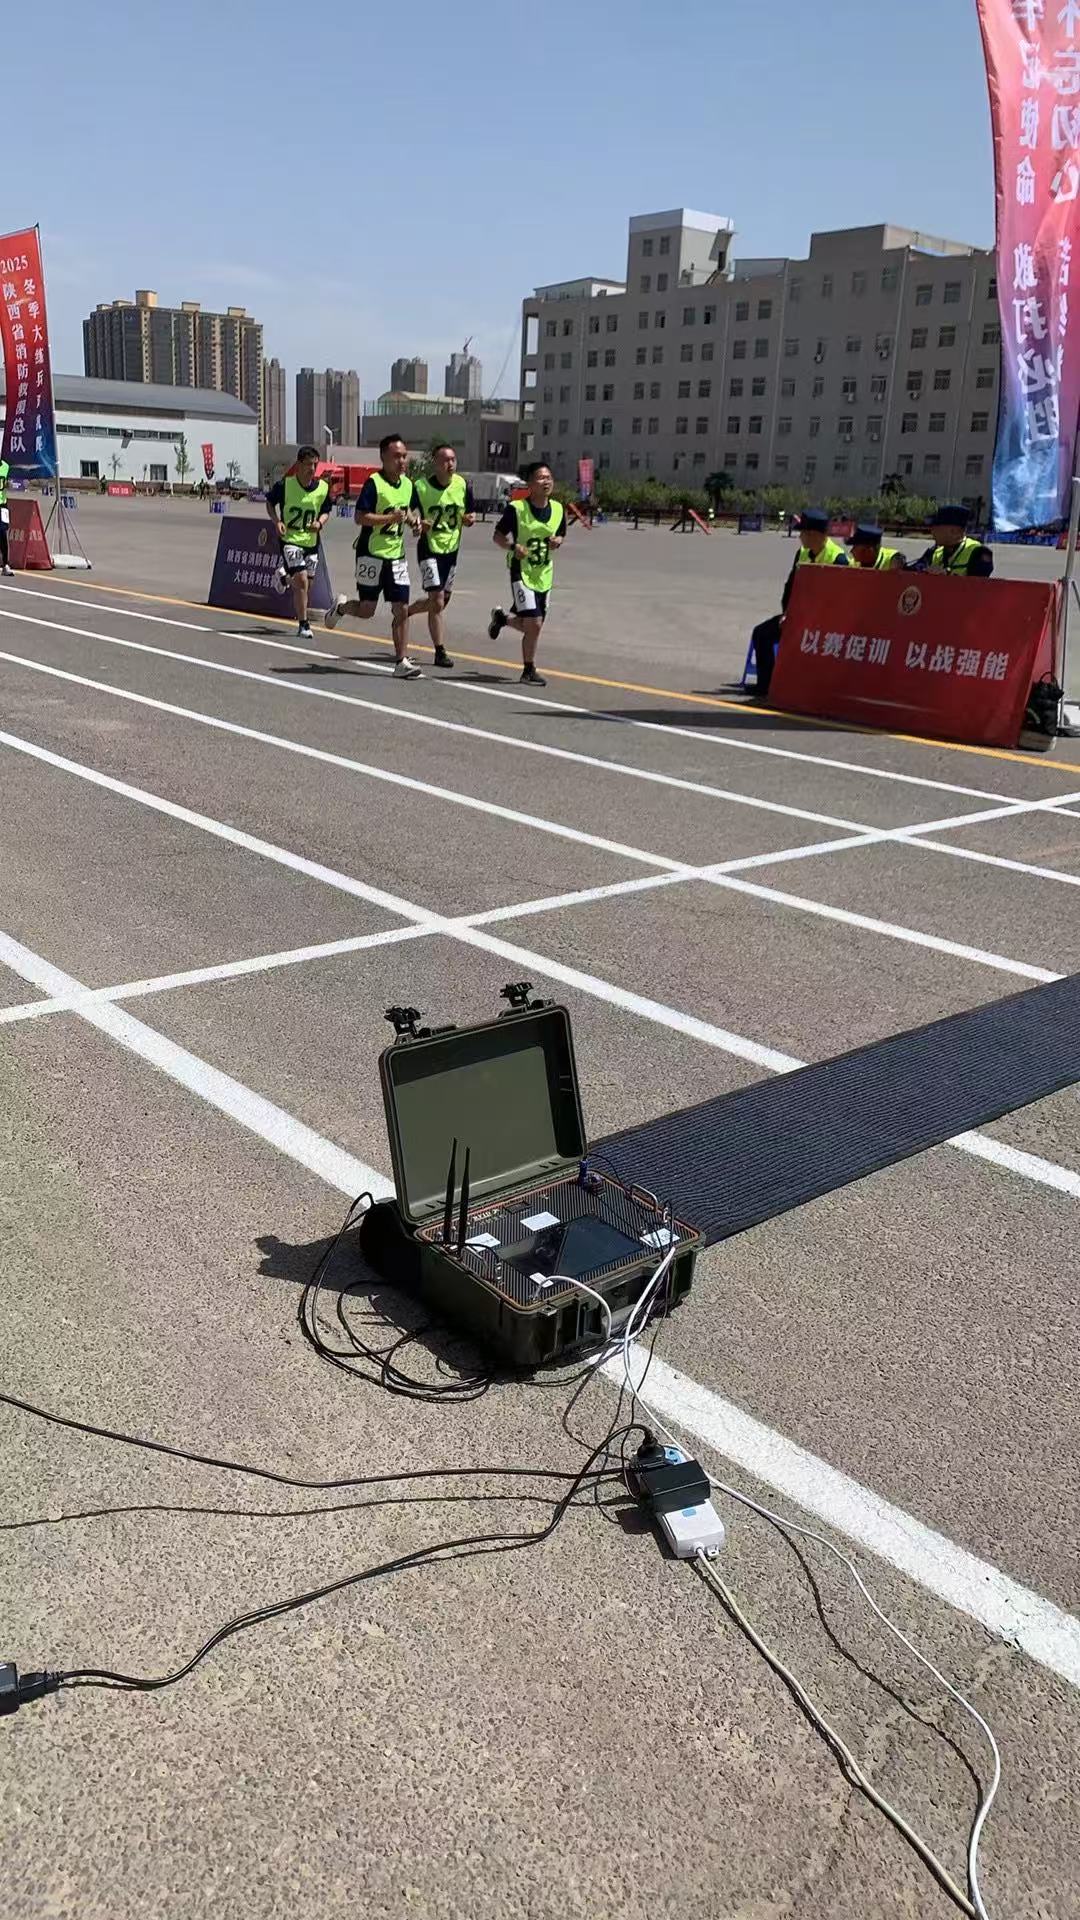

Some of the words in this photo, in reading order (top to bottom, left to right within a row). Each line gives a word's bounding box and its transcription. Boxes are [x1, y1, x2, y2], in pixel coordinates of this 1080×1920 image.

[1, 255, 28, 274] 2025
[3, 281, 30, 454] 陕西省消防救援总队
[428, 503, 459, 531] 23
[358, 563, 378, 580] 26
[800, 628, 892, 666] 以赛促训
[904, 641, 1010, 681] 以战强能
